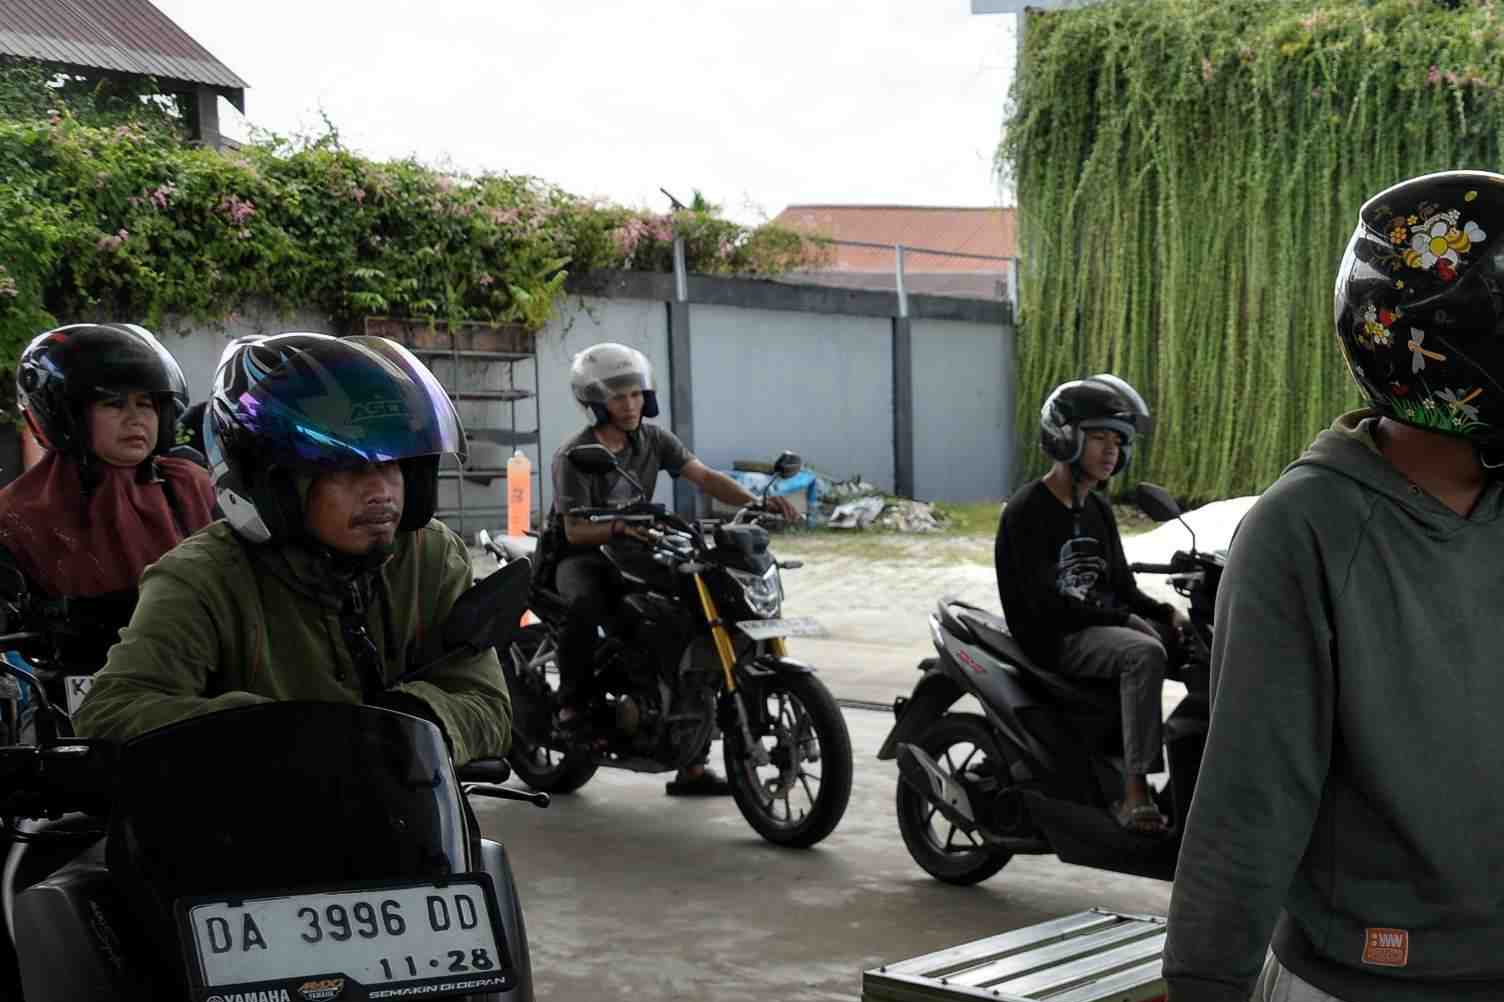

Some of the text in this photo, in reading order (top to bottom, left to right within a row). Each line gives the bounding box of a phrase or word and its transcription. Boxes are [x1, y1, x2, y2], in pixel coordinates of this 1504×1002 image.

[206, 894, 477, 953] DA 3996 DD
[368, 984, 438, 999] SEMAKIN
[456, 976, 506, 990] DEPAN
